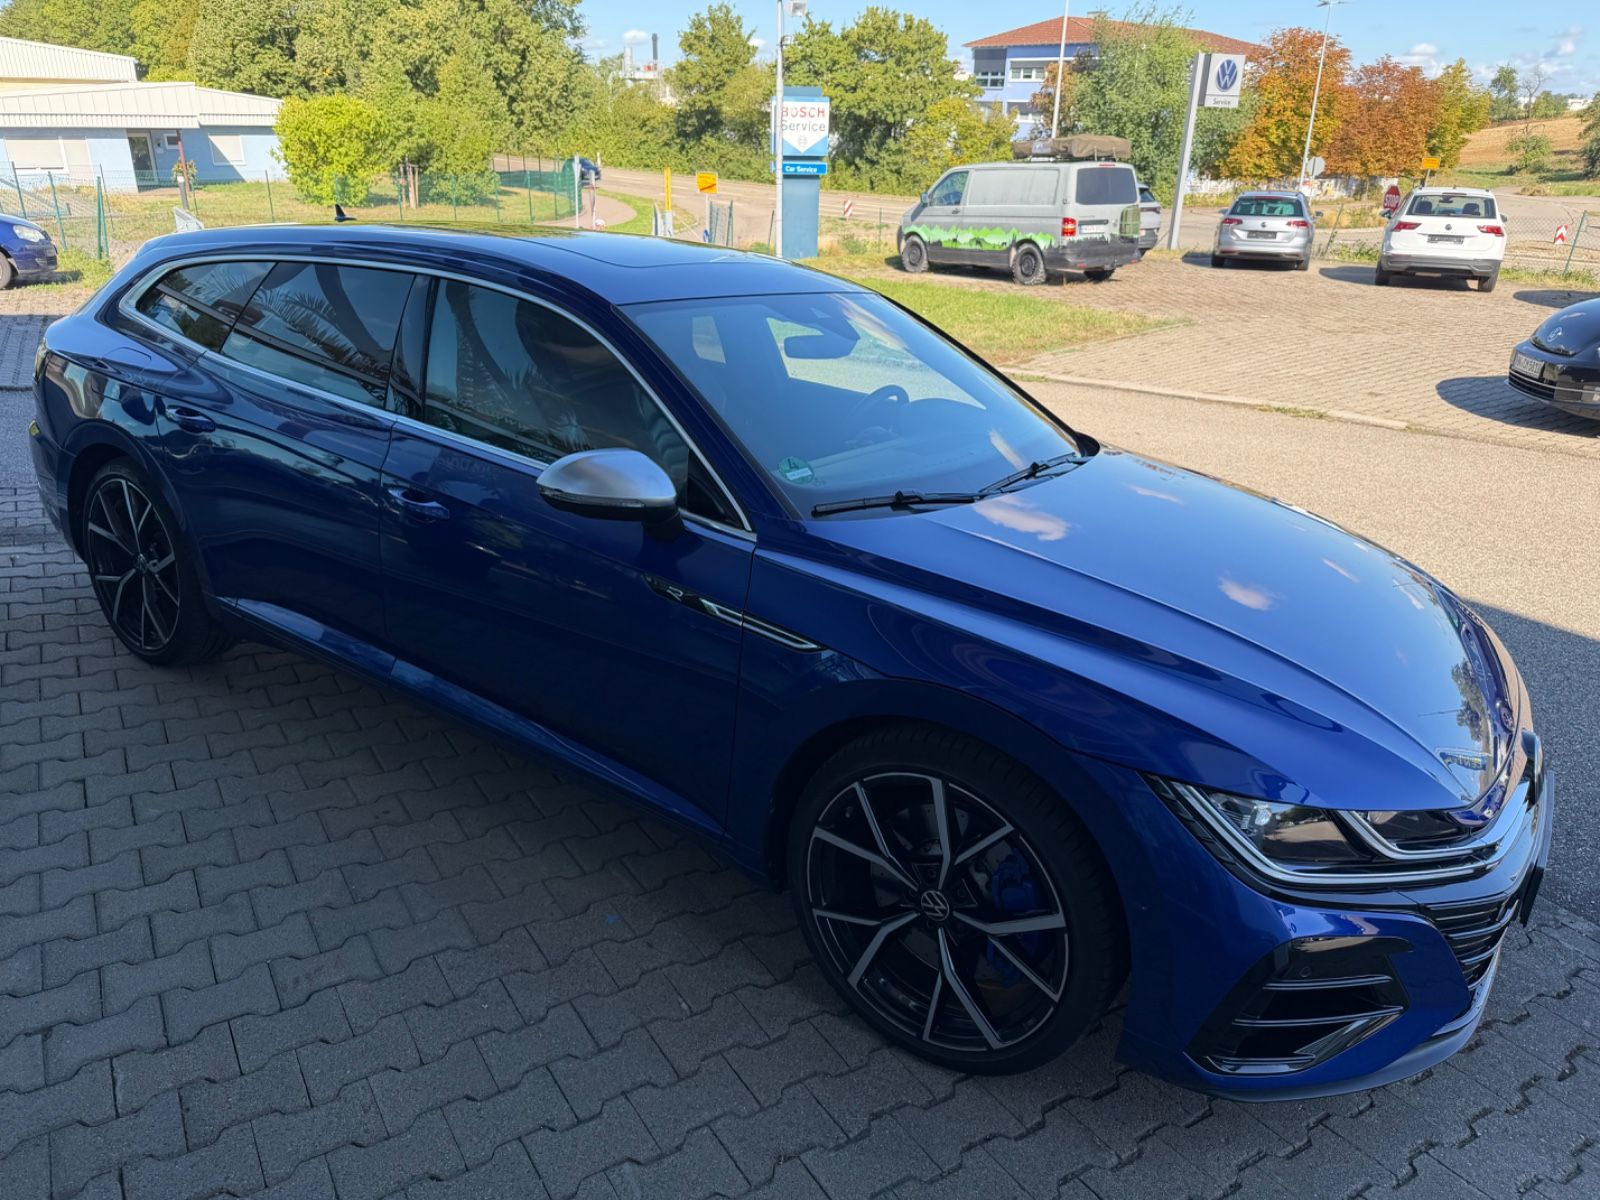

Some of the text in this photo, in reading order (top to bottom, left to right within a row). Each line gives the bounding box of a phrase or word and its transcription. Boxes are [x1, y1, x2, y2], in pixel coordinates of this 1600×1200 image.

[781, 106, 826, 118] BOSCH
[781, 119, 826, 132] Service
[666, 586, 684, 602] R
